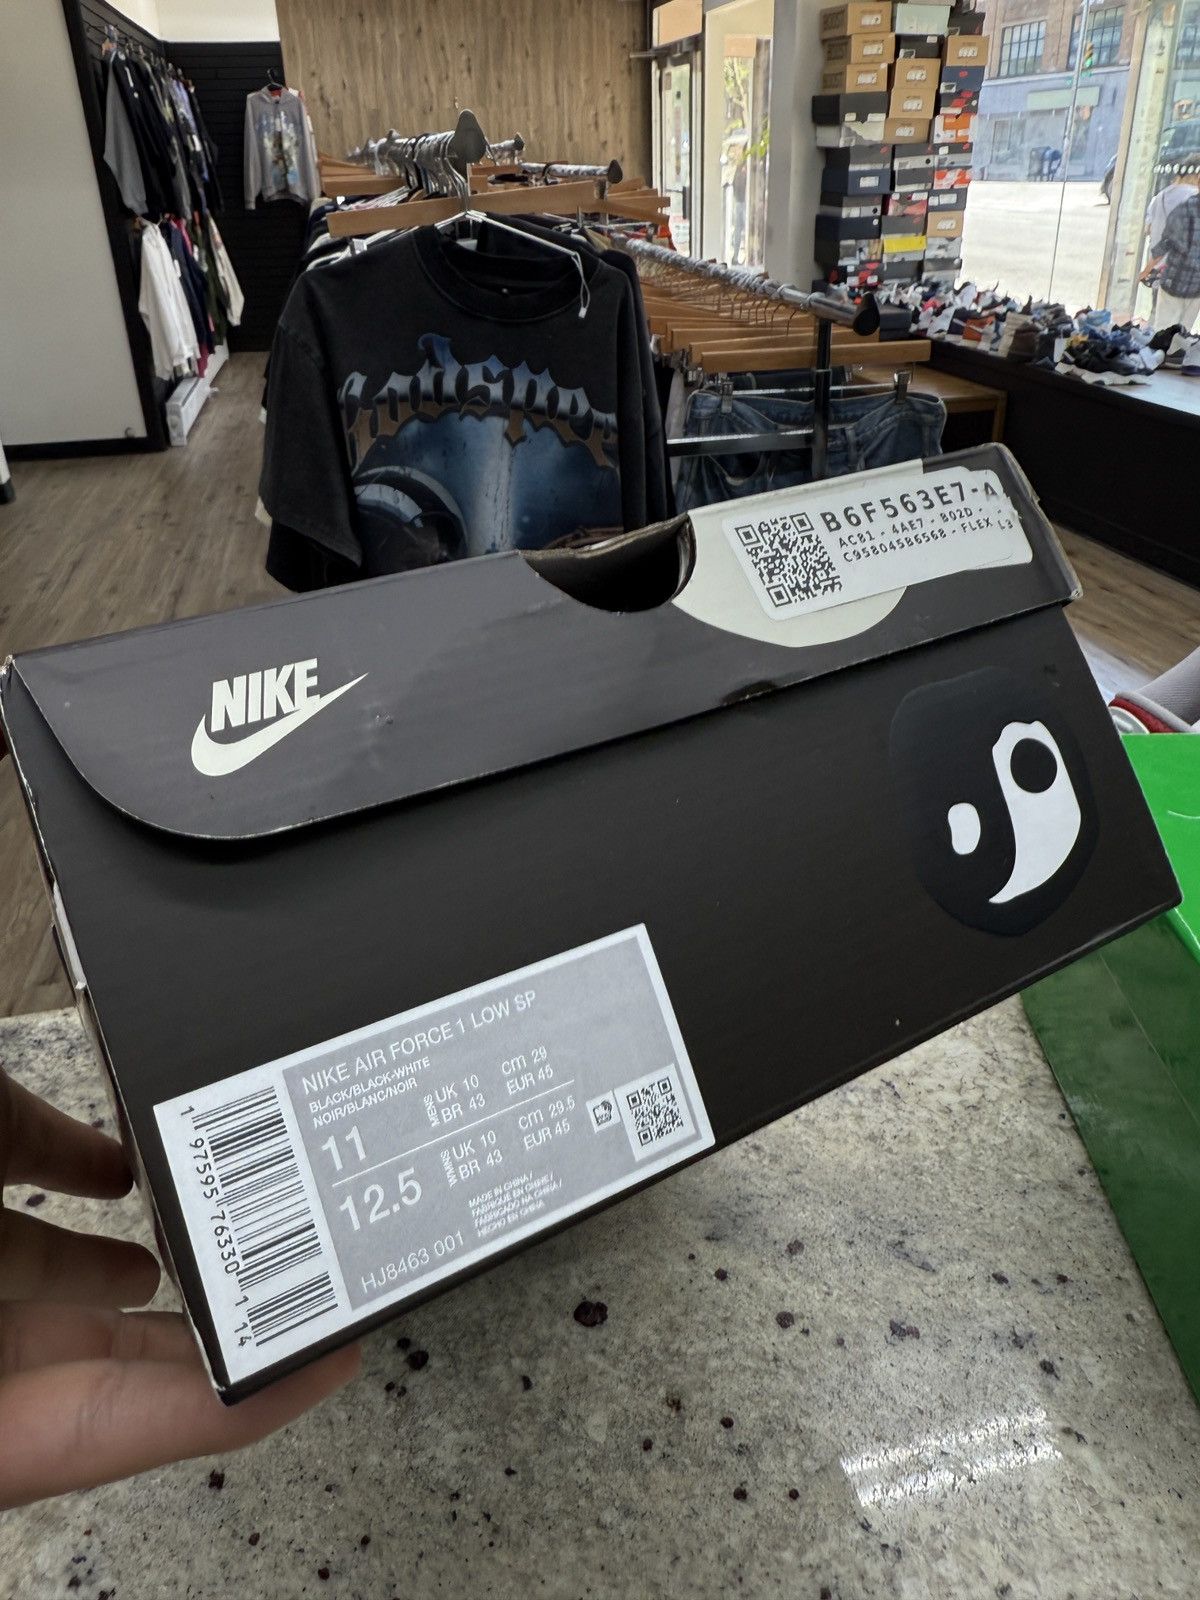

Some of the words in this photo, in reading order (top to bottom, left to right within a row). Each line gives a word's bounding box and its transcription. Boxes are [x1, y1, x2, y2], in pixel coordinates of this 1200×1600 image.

[891, 517, 923, 534] 4AE7
[960, 517, 992, 532] FLEX
[210, 658, 320, 732] NIKE
[301, 1062, 350, 1094] NIKE
[355, 1048, 386, 1075] AIR
[389, 1021, 453, 1060] FORCE
[456, 1017, 465, 1033] 1
[470, 999, 509, 1028] LOW
[513, 990, 535, 1011] SP
[309, 1056, 430, 1113] BLACK/BLACK-WHITE
[313, 1077, 417, 1128] NOIR/BLANC/NOIR
[434, 1082, 457, 1102] UK
[462, 1074, 478, 1090] 10
[531, 1046, 546, 1063] 29
[440, 1102, 462, 1123] BR
[469, 1092, 485, 1109] 43
[506, 1072, 535, 1095] EUR
[321, 1125, 366, 1170] 11
[452, 1139, 475, 1159] UK
[480, 1130, 496, 1147] 10
[548, 1095, 575, 1118] 29.5
[458, 1159, 480, 1179] BR
[486, 1149, 502, 1166] 43
[523, 1126, 552, 1150] EUR
[555, 1118, 569, 1134] 45
[180, 1105, 194, 1116] 1
[189, 1137, 219, 1199] 97595
[210, 1209, 240, 1274] 76330
[234, 1295, 249, 1306] 1
[339, 1166, 421, 1230] 12.5
[361, 1247, 429, 1293] HJ8463
[433, 1230, 463, 1256] 001
[234, 1321, 250, 1346] 14
